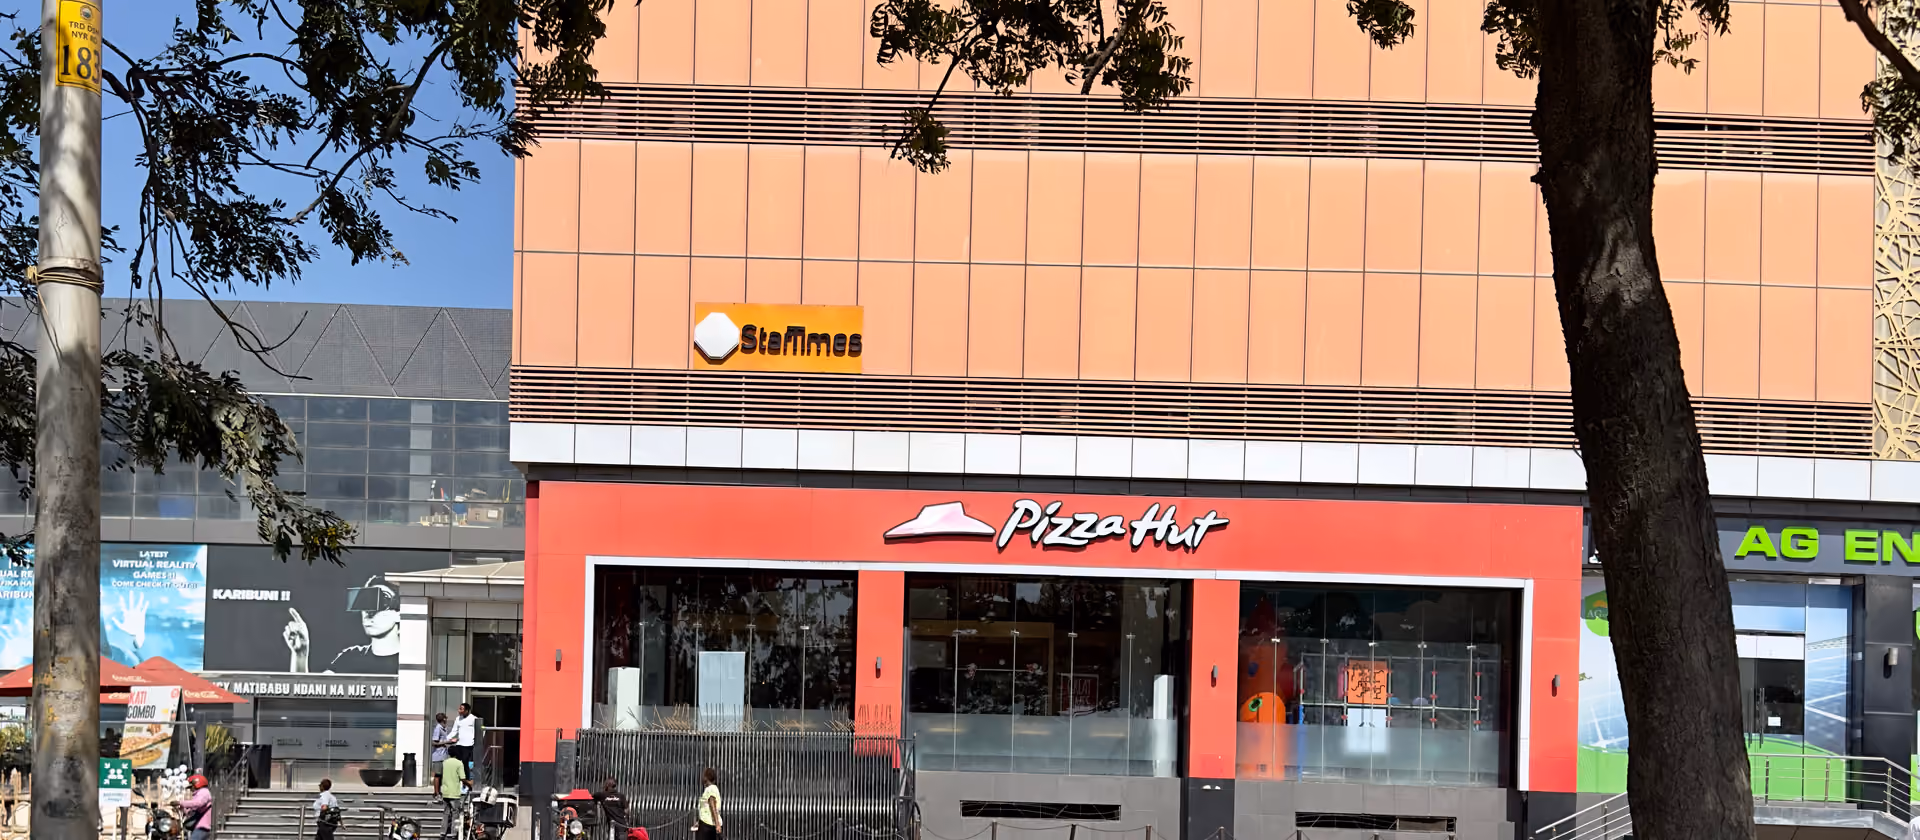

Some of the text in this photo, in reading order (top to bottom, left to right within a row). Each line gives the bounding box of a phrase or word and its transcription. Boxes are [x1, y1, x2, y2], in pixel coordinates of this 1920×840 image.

[69, 21, 85, 30] TRD
[71, 31, 88, 40] NYR
[741, 324, 862, 355] StarTimes
[997, 499, 1230, 550] Pizza Hut
[1735, 526, 1920, 563] AG EN
[112, 560, 197, 569] VIRTUAL REALITY
[133, 571, 166, 579] GAMES
[112, 580, 134, 588] COME
[213, 589, 279, 601] KARIBUNI
[233, 682, 290, 695] MATIBABU
[294, 683, 327, 696] NDANI
[330, 684, 345, 696] NA
[348, 684, 367, 697] NJE
[370, 685, 383, 697] YA
[128, 690, 147, 705] KATI
[127, 705, 156, 719] COMBO
